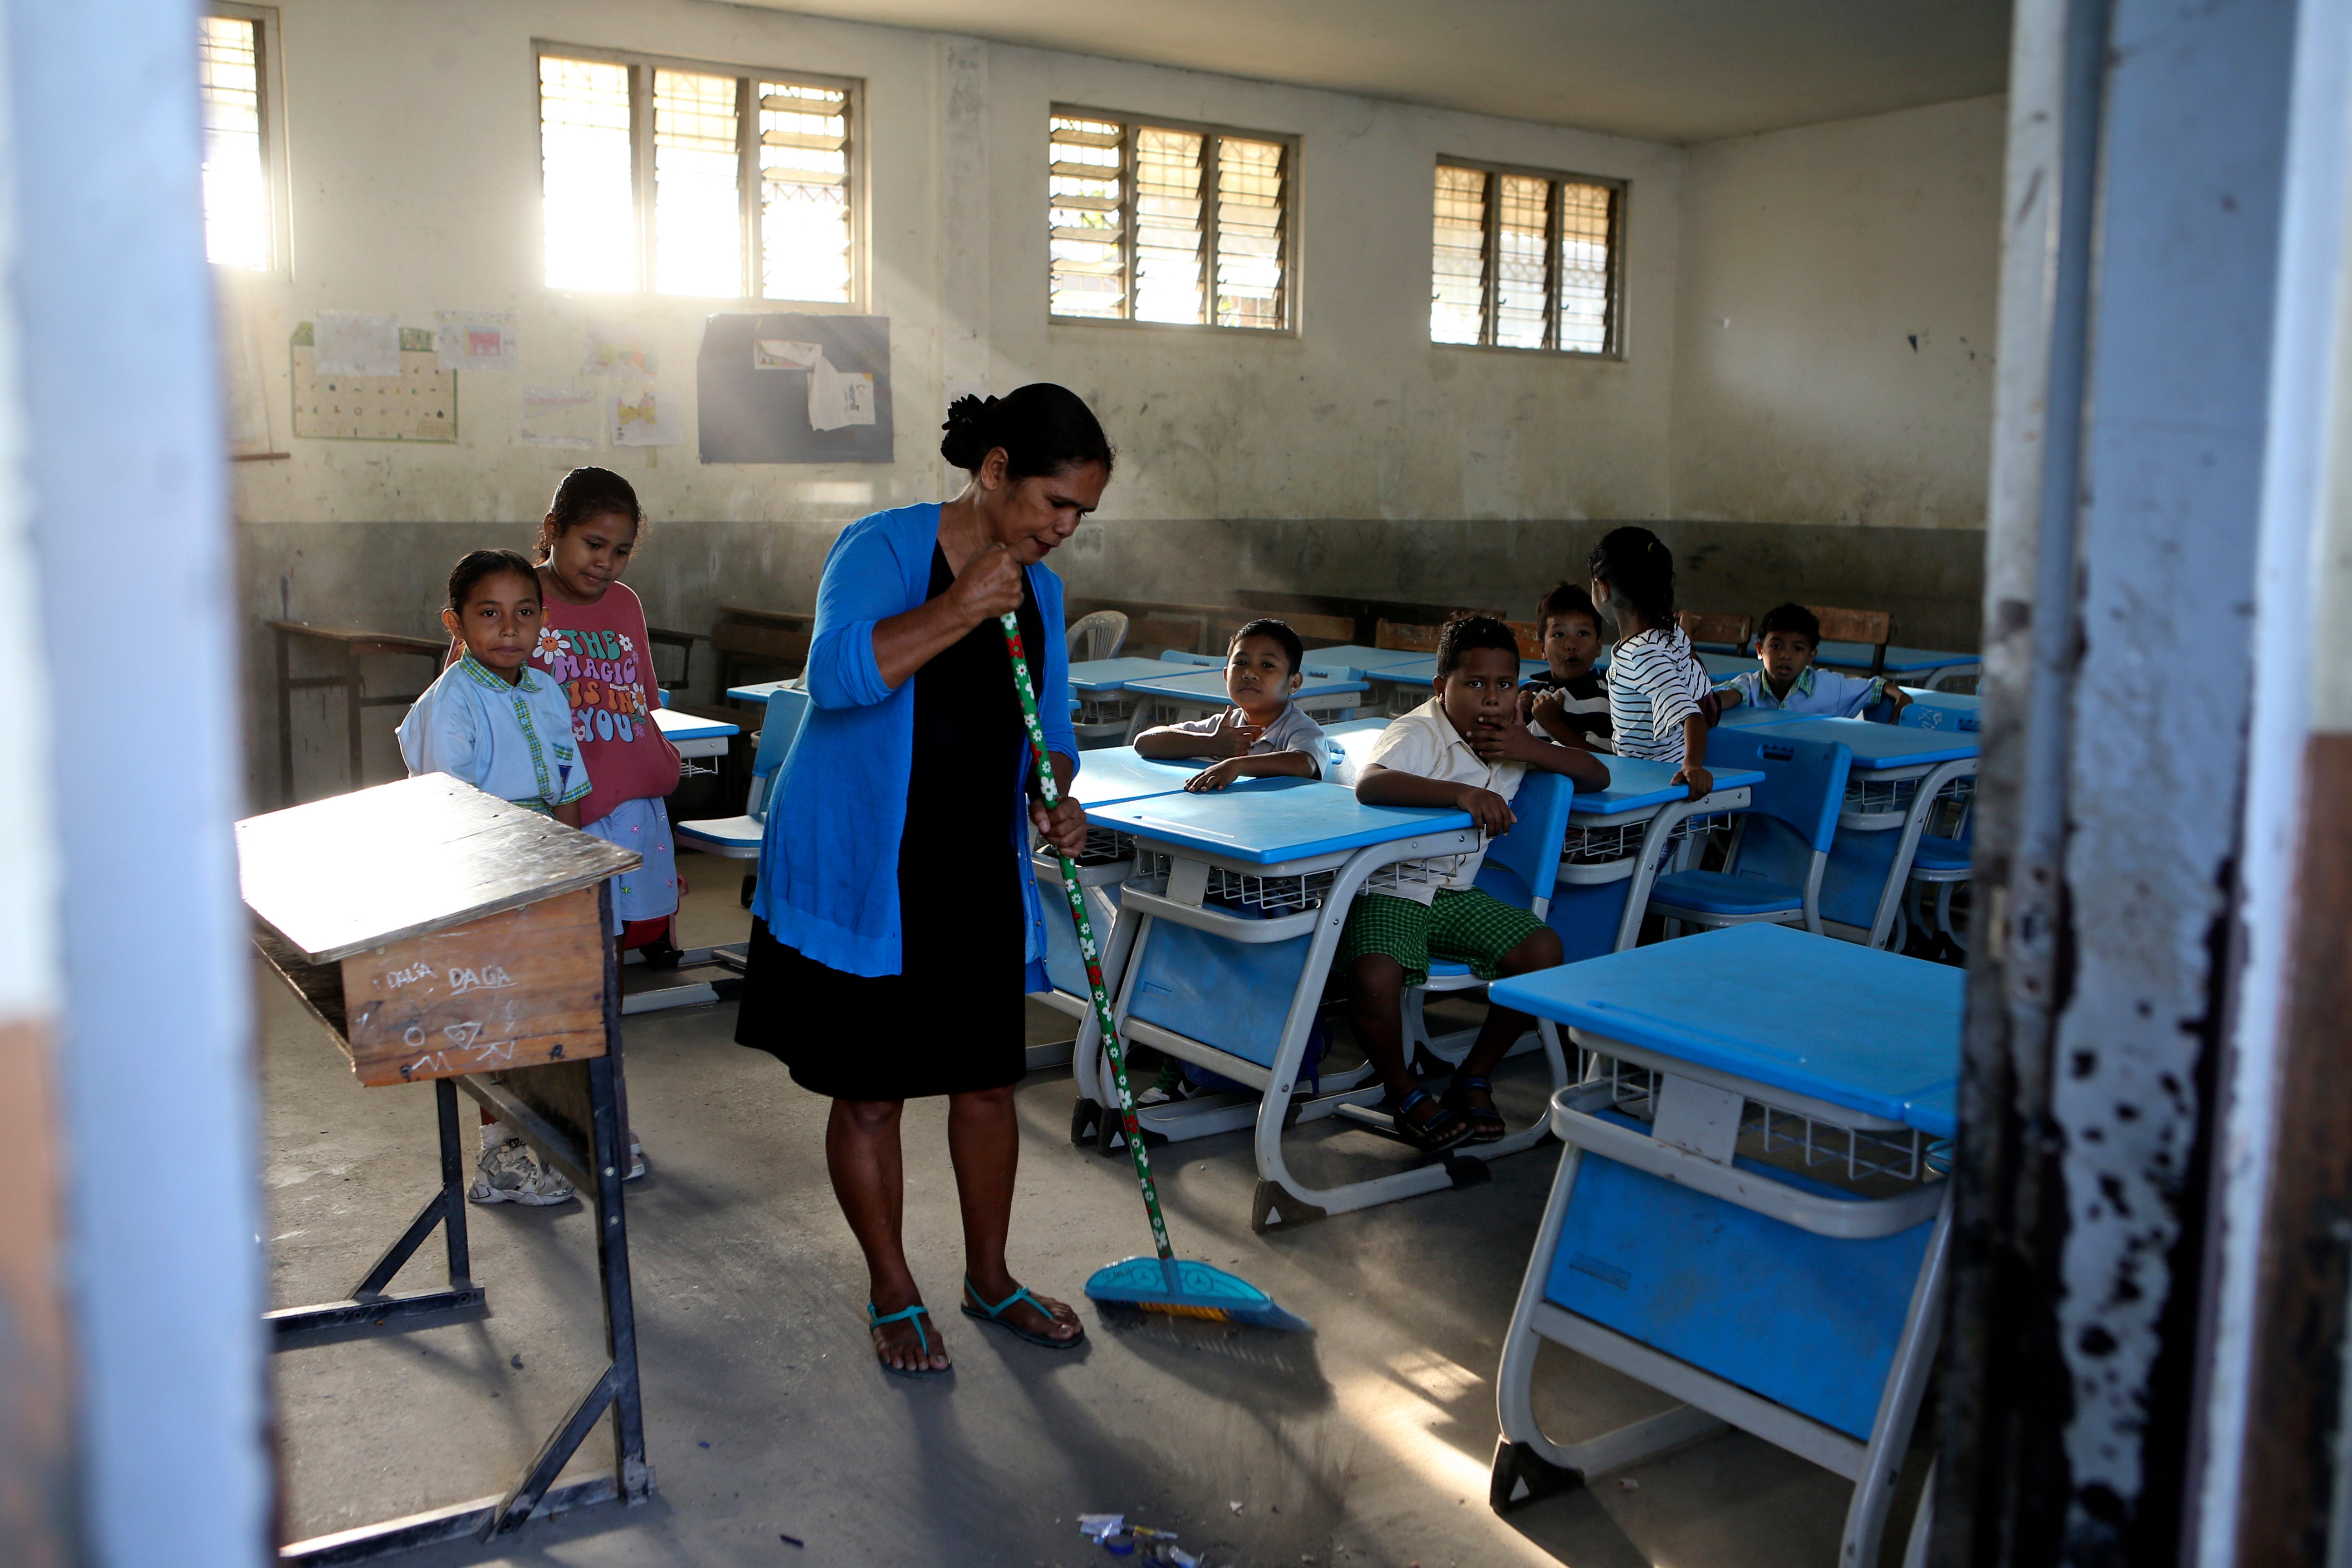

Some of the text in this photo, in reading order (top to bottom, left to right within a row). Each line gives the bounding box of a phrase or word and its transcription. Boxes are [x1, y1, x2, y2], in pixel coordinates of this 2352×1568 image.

[558, 629, 621, 660] THE
[553, 655, 637, 684] MAGIC
[570, 681, 636, 714] IS IN
[578, 707, 634, 742] YOU
